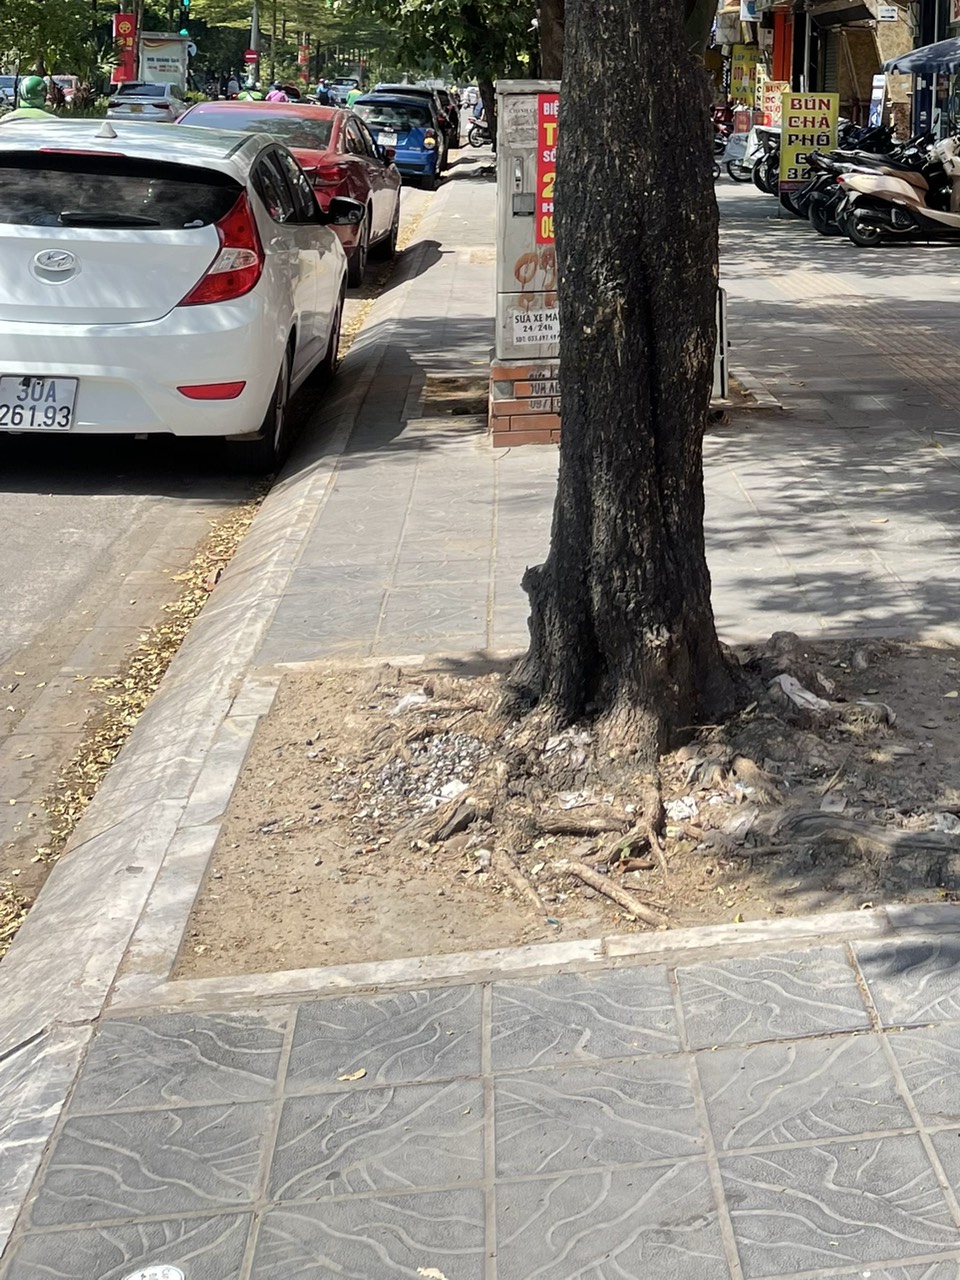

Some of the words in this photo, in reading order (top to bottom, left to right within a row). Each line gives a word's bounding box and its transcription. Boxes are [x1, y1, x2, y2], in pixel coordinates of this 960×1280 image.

[790, 96, 831, 111] BÚN
[788, 113, 831, 128] CHẢ
[788, 130, 831, 147] PHỐ
[533, 313, 543, 322] XE
[17, 380, 57, 403] 30A
[0, 404, 71, 428] 261.93
